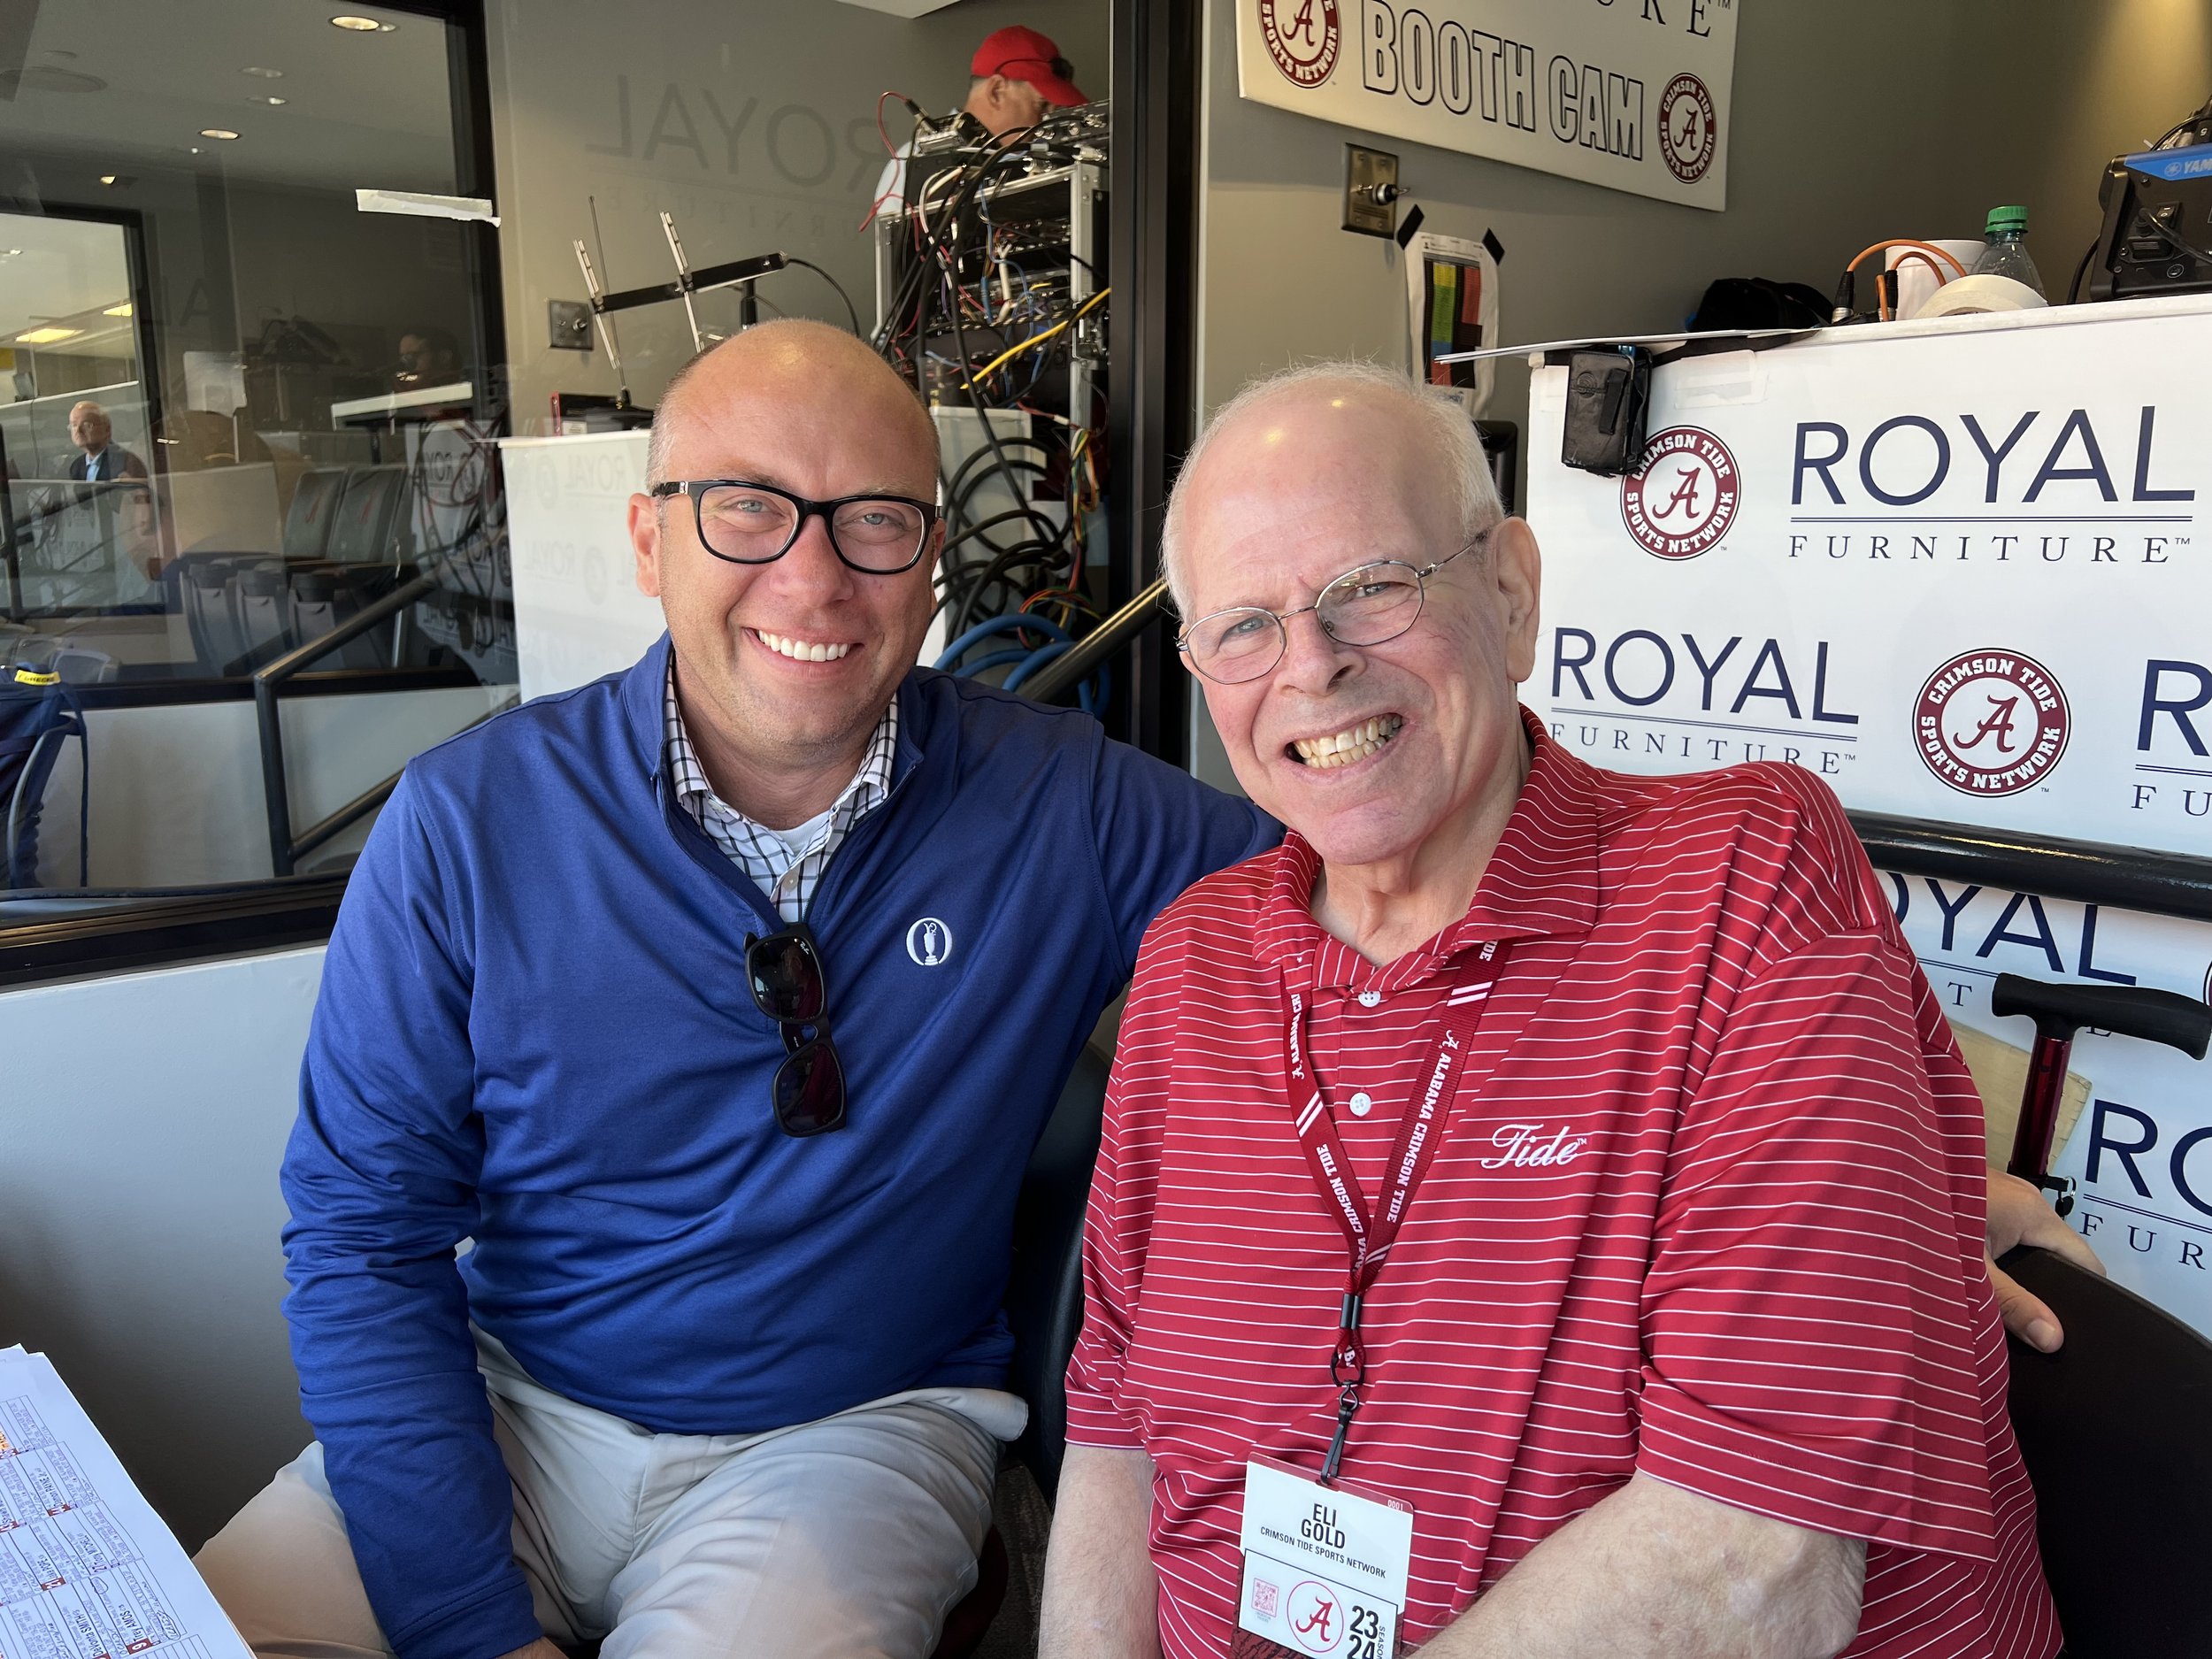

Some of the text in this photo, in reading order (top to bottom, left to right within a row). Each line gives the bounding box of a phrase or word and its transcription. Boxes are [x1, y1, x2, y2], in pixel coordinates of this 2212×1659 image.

[1362, 0, 1644, 161] BOOTH CAM
[1663, 81, 1712, 122] CRIMSON TIDE
[1661, 121, 1713, 177] SPORTS NETWORK
[1700, 440, 1731, 479] TIDE
[1791, 405, 2195, 506] ROYAL
[1626, 491, 1733, 553] SPORTS NETWORK
[1551, 626, 1859, 724] ROYAL
[1928, 657, 2057, 712] CRIMSON TIDE
[1921, 716, 2061, 789] SPORTS NETWORK
[1418, 1052, 1452, 1120] ALABAMA
[1316, 1143, 1337, 1177] TIDE
[1397, 1122, 1428, 1187] CRIMSON
[1329, 1177, 1363, 1233] CRIMSON
[1386, 1189, 1406, 1224] TIDE
[1301, 1519, 1346, 1549] GOLD
[1313, 1503, 1338, 1527] ELI
[1260, 1526, 1386, 1578] CRIMSON TIDE SPORTS NETWORK
[74, 1613, 92, 1634] SMITH
[119, 1609, 137, 1630] AMOS
[1349, 1605, 1379, 1640] 23
[1347, 1634, 1376, 1659] 24
